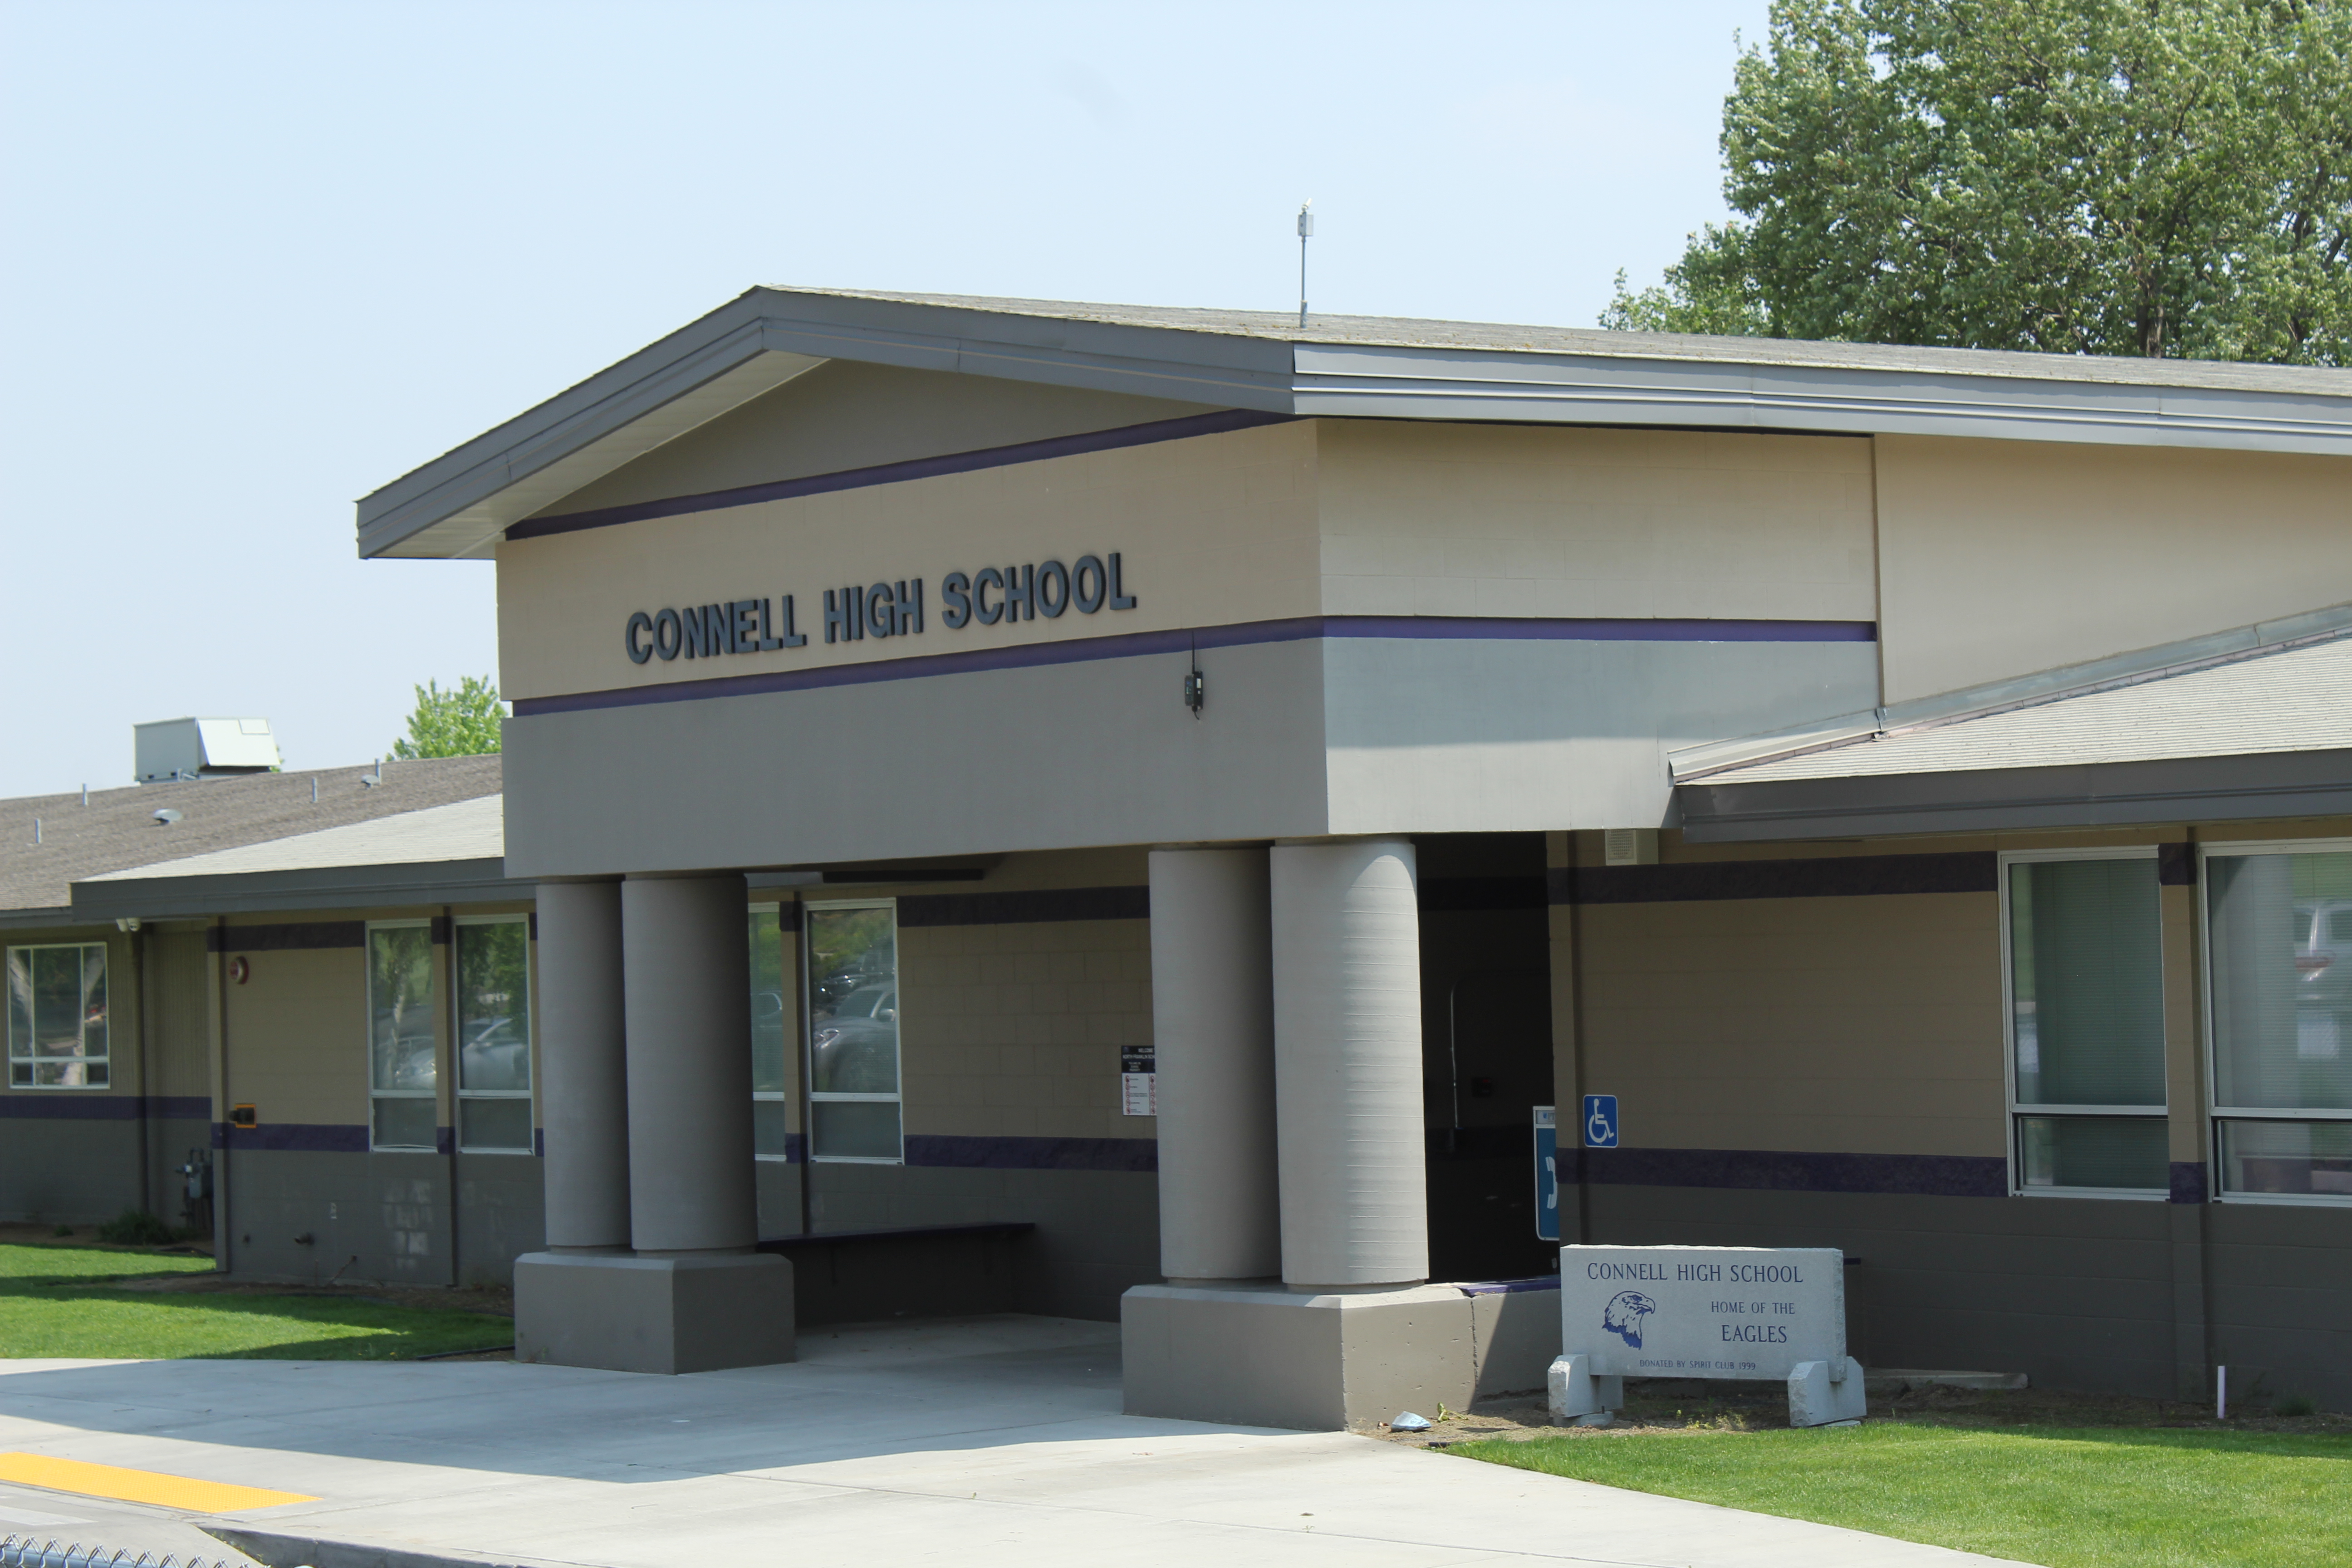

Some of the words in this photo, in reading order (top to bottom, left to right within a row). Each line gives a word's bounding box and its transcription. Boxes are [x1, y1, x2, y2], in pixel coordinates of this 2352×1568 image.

[626, 594, 807, 664] CONNELL
[823, 578, 923, 644] HIGH
[941, 552, 1137, 629] SCHOOL
[1588, 1263, 1668, 1280] CONNELL
[1677, 1264, 1721, 1281] HIGH
[1730, 1265, 1803, 1283] SCHOOL
[1711, 1301, 1745, 1313] HOME
[1751, 1302, 1766, 1313] OF
[1772, 1303, 1795, 1314] THE
[1721, 1325, 1787, 1343] EAGLES
[1640, 1359, 1673, 1367] DONATED
[1690, 1361, 1711, 1369] SPIRIT
[1715, 1361, 1734, 1369] CLUB
